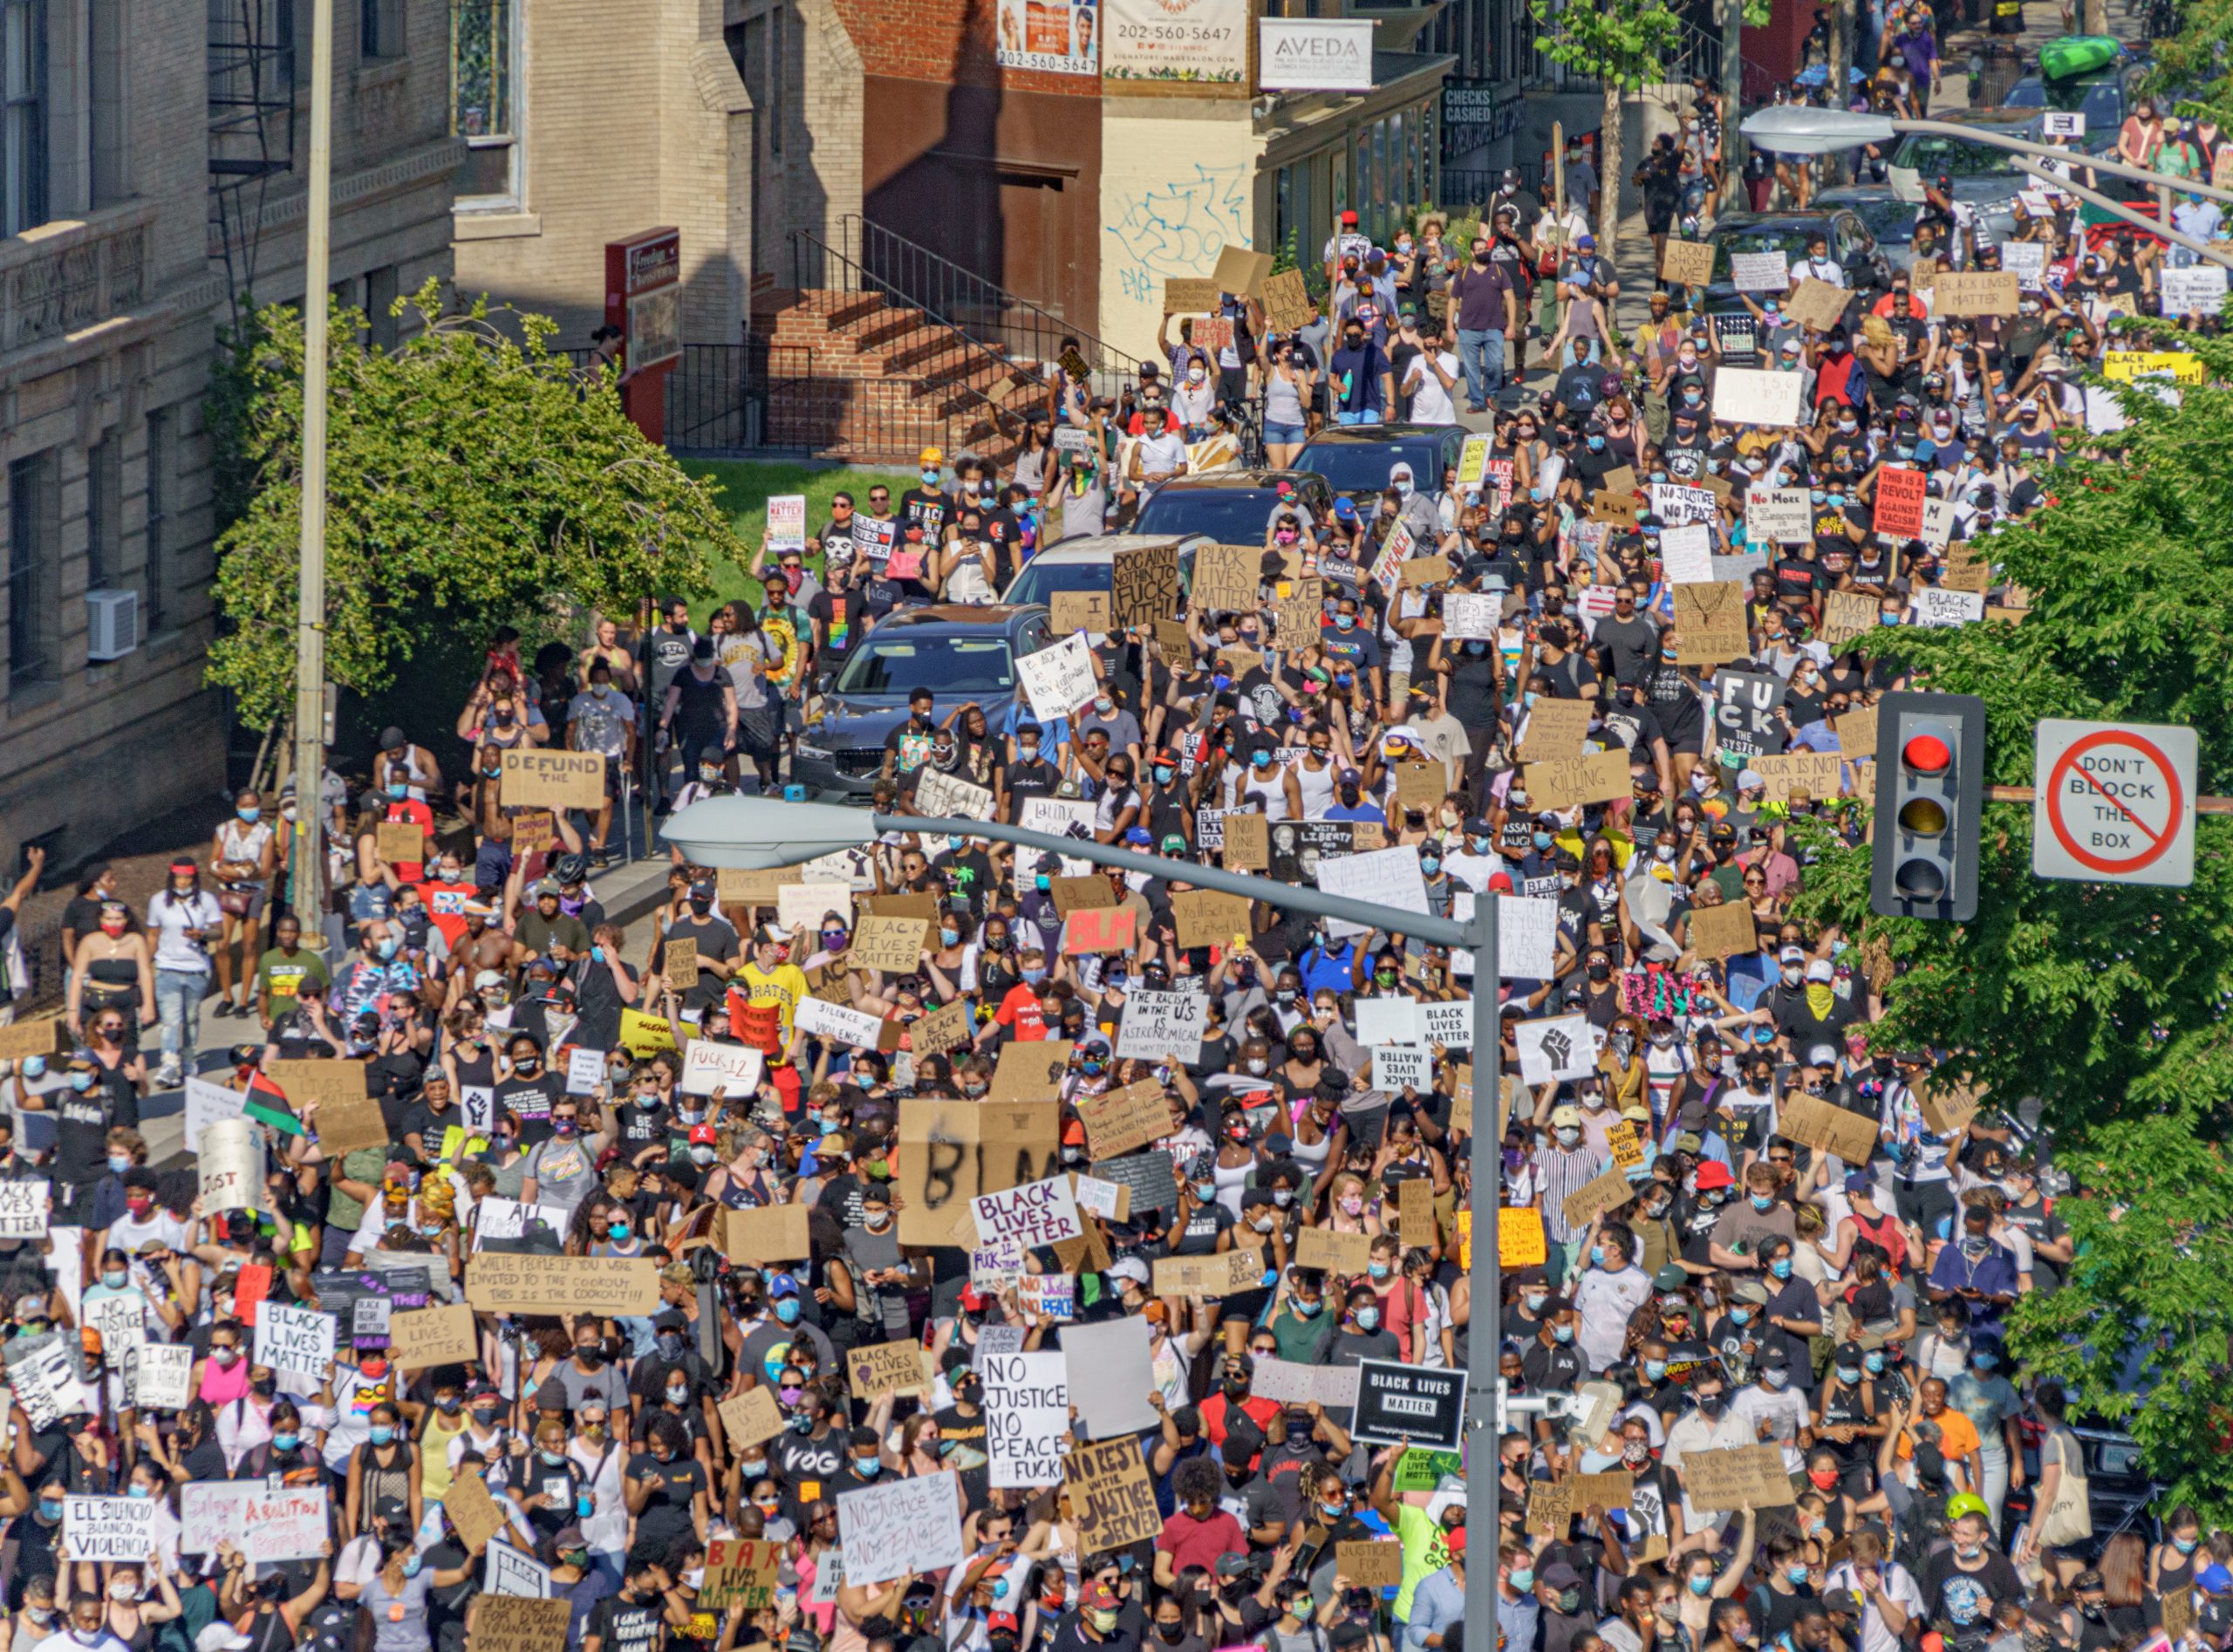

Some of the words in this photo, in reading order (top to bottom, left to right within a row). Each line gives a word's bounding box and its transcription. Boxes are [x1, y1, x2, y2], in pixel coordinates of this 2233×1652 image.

[1117, 24, 1232, 41] 202-560-5647
[1274, 38, 1359, 57] AVEDA
[999, 50, 1097, 73] 202-560-5647
[1445, 90, 1491, 106] CHECKS
[1445, 107, 1491, 123] CASHED
[1670, 254, 1711, 267] SHOOT
[1678, 266, 1700, 282] ME
[1266, 275, 1306, 299] BLACK
[1940, 279, 1976, 292] BLACK
[1980, 277, 2011, 290] LIVES
[1953, 294, 1999, 305] MATTER
[1194, 320, 1231, 331] BLACK
[1195, 330, 1231, 338] LIVES
[2107, 354, 2145, 364] BLACK
[1465, 443, 1484, 454] BLACK
[1883, 472, 1903, 482] THIS
[1905, 474, 1913, 483] IS
[1660, 486, 1674, 499] NO
[1676, 488, 1714, 505] JUSTICE
[1772, 494, 1800, 503] MORE
[1881, 485, 1922, 501] REVOLT
[909, 506, 944, 520] BLACK
[1602, 502, 1628, 515] BLM
[1663, 505, 1681, 518] NO
[1684, 506, 1715, 521] PEACE
[1878, 502, 1921, 515] AGAINST
[1880, 512, 1916, 525] RACISM
[1752, 526, 1799, 537] SILENCE
[1114, 553, 1143, 569] POC
[1201, 547, 1246, 569] BLACK
[1199, 569, 1248, 588] LIVES
[1118, 582, 1174, 611] FUCK
[1195, 587, 1260, 609] MATTER!
[1284, 582, 1321, 601] WE
[1676, 587, 1738, 611] BLACK
[1928, 592, 1970, 607] BLACK
[1832, 592, 1878, 610] DIVEST
[1116, 601, 1171, 627] WITH!
[1933, 607, 1965, 619] LIVES
[1279, 611, 1319, 632] BLACK
[1677, 613, 1742, 632] LIVES
[1681, 633, 1745, 655] MATTER
[1736, 729, 1752, 741] THE
[1722, 738, 1764, 755] SYSTEM
[507, 755, 599, 774] DEFUND
[1554, 756, 1588, 774] STOP
[1797, 757, 1808, 774] IS
[1813, 755, 1841, 772] NOT
[2084, 757, 2145, 775] DON'T
[538, 773, 569, 783] THE
[1549, 767, 1606, 794] KILLING
[1566, 789, 1588, 804] US
[2070, 779, 2155, 799] BLOCK
[1200, 808, 1249, 822] BLACK
[2094, 806, 2133, 823] THE
[1235, 819, 1255, 833] NOT
[1233, 834, 1257, 847] ONE
[1301, 833, 1352, 843] LIBERTY
[2092, 832, 2131, 849] BOX
[1230, 850, 1260, 862] MORE
[1319, 850, 1354, 859] JUSTICE
[725, 877, 760, 889] LIVES
[860, 919, 922, 934] BLACK
[1067, 912, 1135, 951] BLM
[856, 936, 918, 952] LIVES
[851, 952, 915, 966] MATTER
[1130, 991, 1151, 1003] THE
[1157, 993, 1192, 1005] RACISM
[818, 1003, 859, 1024] SILENCE
[1137, 1005, 1147, 1014] IN
[1151, 1006, 1168, 1015] THE
[1426, 1008, 1464, 1020] BLACK
[926, 1014, 959, 1036] BLACK
[1155, 1017, 1165, 1028] IS
[1431, 1020, 1463, 1031] LIVES
[919, 1032, 951, 1051] LIVES
[1123, 1027, 1199, 1041] ASTRONOMICAL
[1424, 1031, 1471, 1043] MATTER
[691, 1047, 726, 1068] FUCK
[726, 1060, 752, 1078] 12
[1386, 1064, 1416, 1075] LIVES
[298, 1078, 344, 1091] LIVES
[1384, 1075, 1419, 1087] BLACK
[636, 1115, 652, 1128] BE
[1610, 1124, 1626, 1134] NO
[697, 1127, 707, 1138] X
[1608, 1133, 1636, 1146] JUSTICE
[1617, 1142, 1631, 1151] NO
[1615, 1150, 1642, 1163] PEACE
[202, 1172, 237, 1196] JUST
[978, 1182, 1059, 1220] BLACK
[994, 1205, 1053, 1233] LIVES
[477, 1258, 514, 1271] WHITE
[520, 1258, 553, 1271] PEOPLE
[559, 1259, 572, 1271] IF
[577, 1259, 599, 1271] YOU
[606, 1259, 633, 1272] WERE
[468, 1273, 520, 1286] INVITED
[523, 1273, 540, 1285] TO
[545, 1275, 566, 1286] THE
[571, 1275, 632, 1290] COOKOUT
[1019, 1276, 1041, 1293] NO
[488, 1288, 514, 1300] THIS
[520, 1290, 537, 1300] IS
[545, 1289, 567, 1300] THE
[103, 1299, 126, 1314] NO
[1019, 1297, 1041, 1313] NO
[93, 1311, 143, 1332] JUSTICE
[268, 1304, 326, 1335] BLACK
[399, 1312, 447, 1328] BLACK
[109, 1332, 133, 1348] NO
[270, 1329, 321, 1352] LIVES
[409, 1327, 452, 1341] LIVES
[984, 1328, 1016, 1341] BLACK
[262, 1346, 329, 1377] MATTER
[850, 1347, 893, 1364] BLACK
[1558, 1358, 1574, 1369] AX
[874, 1355, 912, 1373] LIVES
[986, 1356, 1027, 1383] NO
[864, 1371, 922, 1393] MATTER
[1370, 1373, 1410, 1391] BLACK
[1417, 1377, 1451, 1396] LIVES
[986, 1384, 1069, 1410] JUSTICE
[1388, 1398, 1432, 1414] MATTER
[988, 1412, 1021, 1439] NO
[991, 1437, 1066, 1458] PEACE
[1062, 1454, 1098, 1484] NO
[1097, 1438, 1142, 1474] REST
[1409, 1452, 1435, 1461] BLACK
[1407, 1462, 1431, 1471] LIVES
[1405, 1471, 1439, 1481] MATTER
[1696, 1489, 1739, 1501] American
[74, 1503, 96, 1520] EL
[101, 1503, 153, 1520] SILENCIO
[1532, 1500, 1568, 1514] LIVES
[847, 1503, 870, 1532] NO
[1529, 1511, 1570, 1525] MATTER
[85, 1522, 132, 1535] BLANCO
[1100, 1509, 1160, 1546] SERVED
[73, 1537, 151, 1555] VIOLENCIA
[857, 1539, 883, 1567] NO
[1341, 1546, 1392, 1558] JUSTICE
[1359, 1559, 1380, 1571] FOR
[1354, 1572, 1389, 1584] SEAN
[700, 1585, 770, 1608] MATTER
[483, 1598, 557, 1613] JUSTICE
[482, 1610, 510, 1622] FOR
